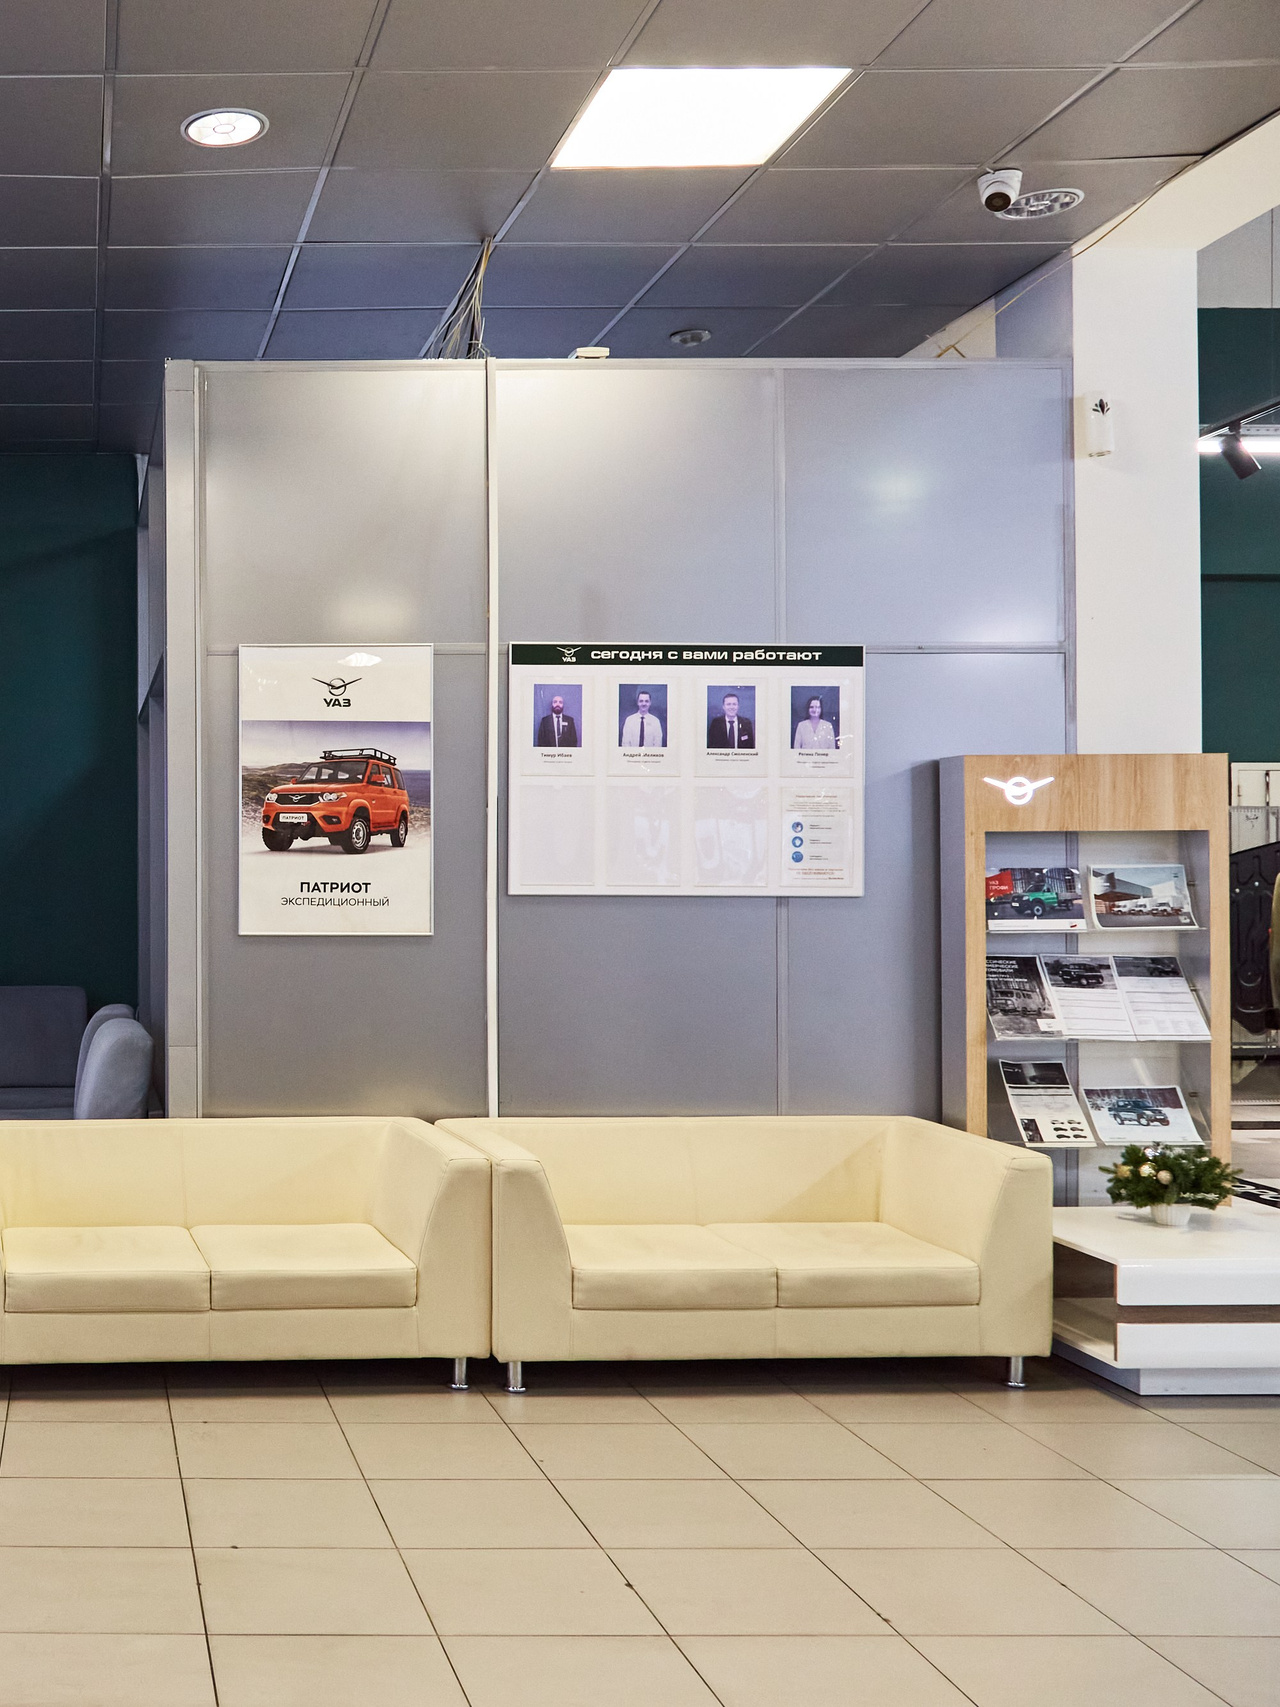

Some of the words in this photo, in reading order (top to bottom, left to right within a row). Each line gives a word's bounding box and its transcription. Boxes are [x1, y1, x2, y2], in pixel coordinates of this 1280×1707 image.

[590, 650, 663, 662] сегодня
[667, 650, 679, 660] с
[682, 650, 728, 660] вами
[732, 649, 823, 663] работают
[323, 698, 352, 708] УАЗ
[300, 881, 372, 894] ПАТРИОТ
[280, 895, 390, 908] ЭКСПЕДИЦИОННЫЙ
